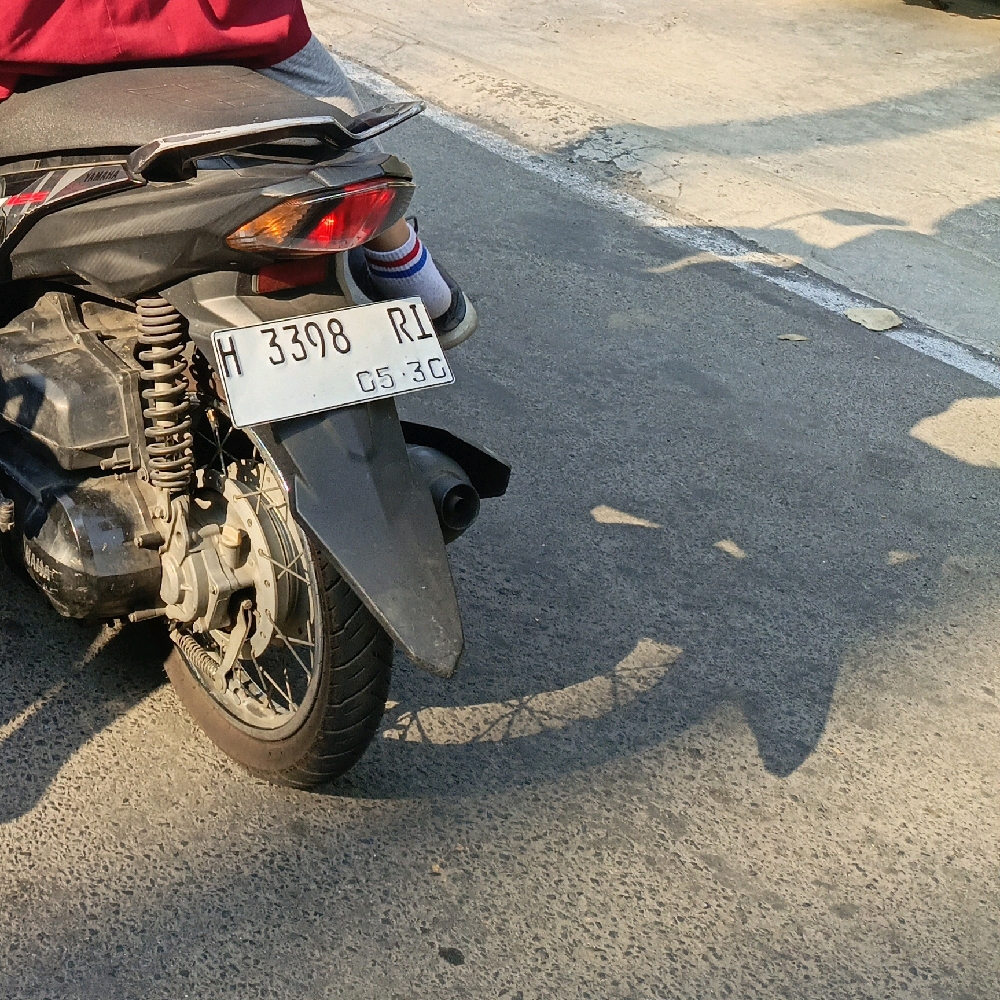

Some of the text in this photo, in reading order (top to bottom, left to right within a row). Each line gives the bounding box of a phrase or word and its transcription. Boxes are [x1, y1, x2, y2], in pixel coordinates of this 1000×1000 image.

[83, 169, 120, 183] YAMAHA
[216, 303, 434, 378] H 3398 RI
